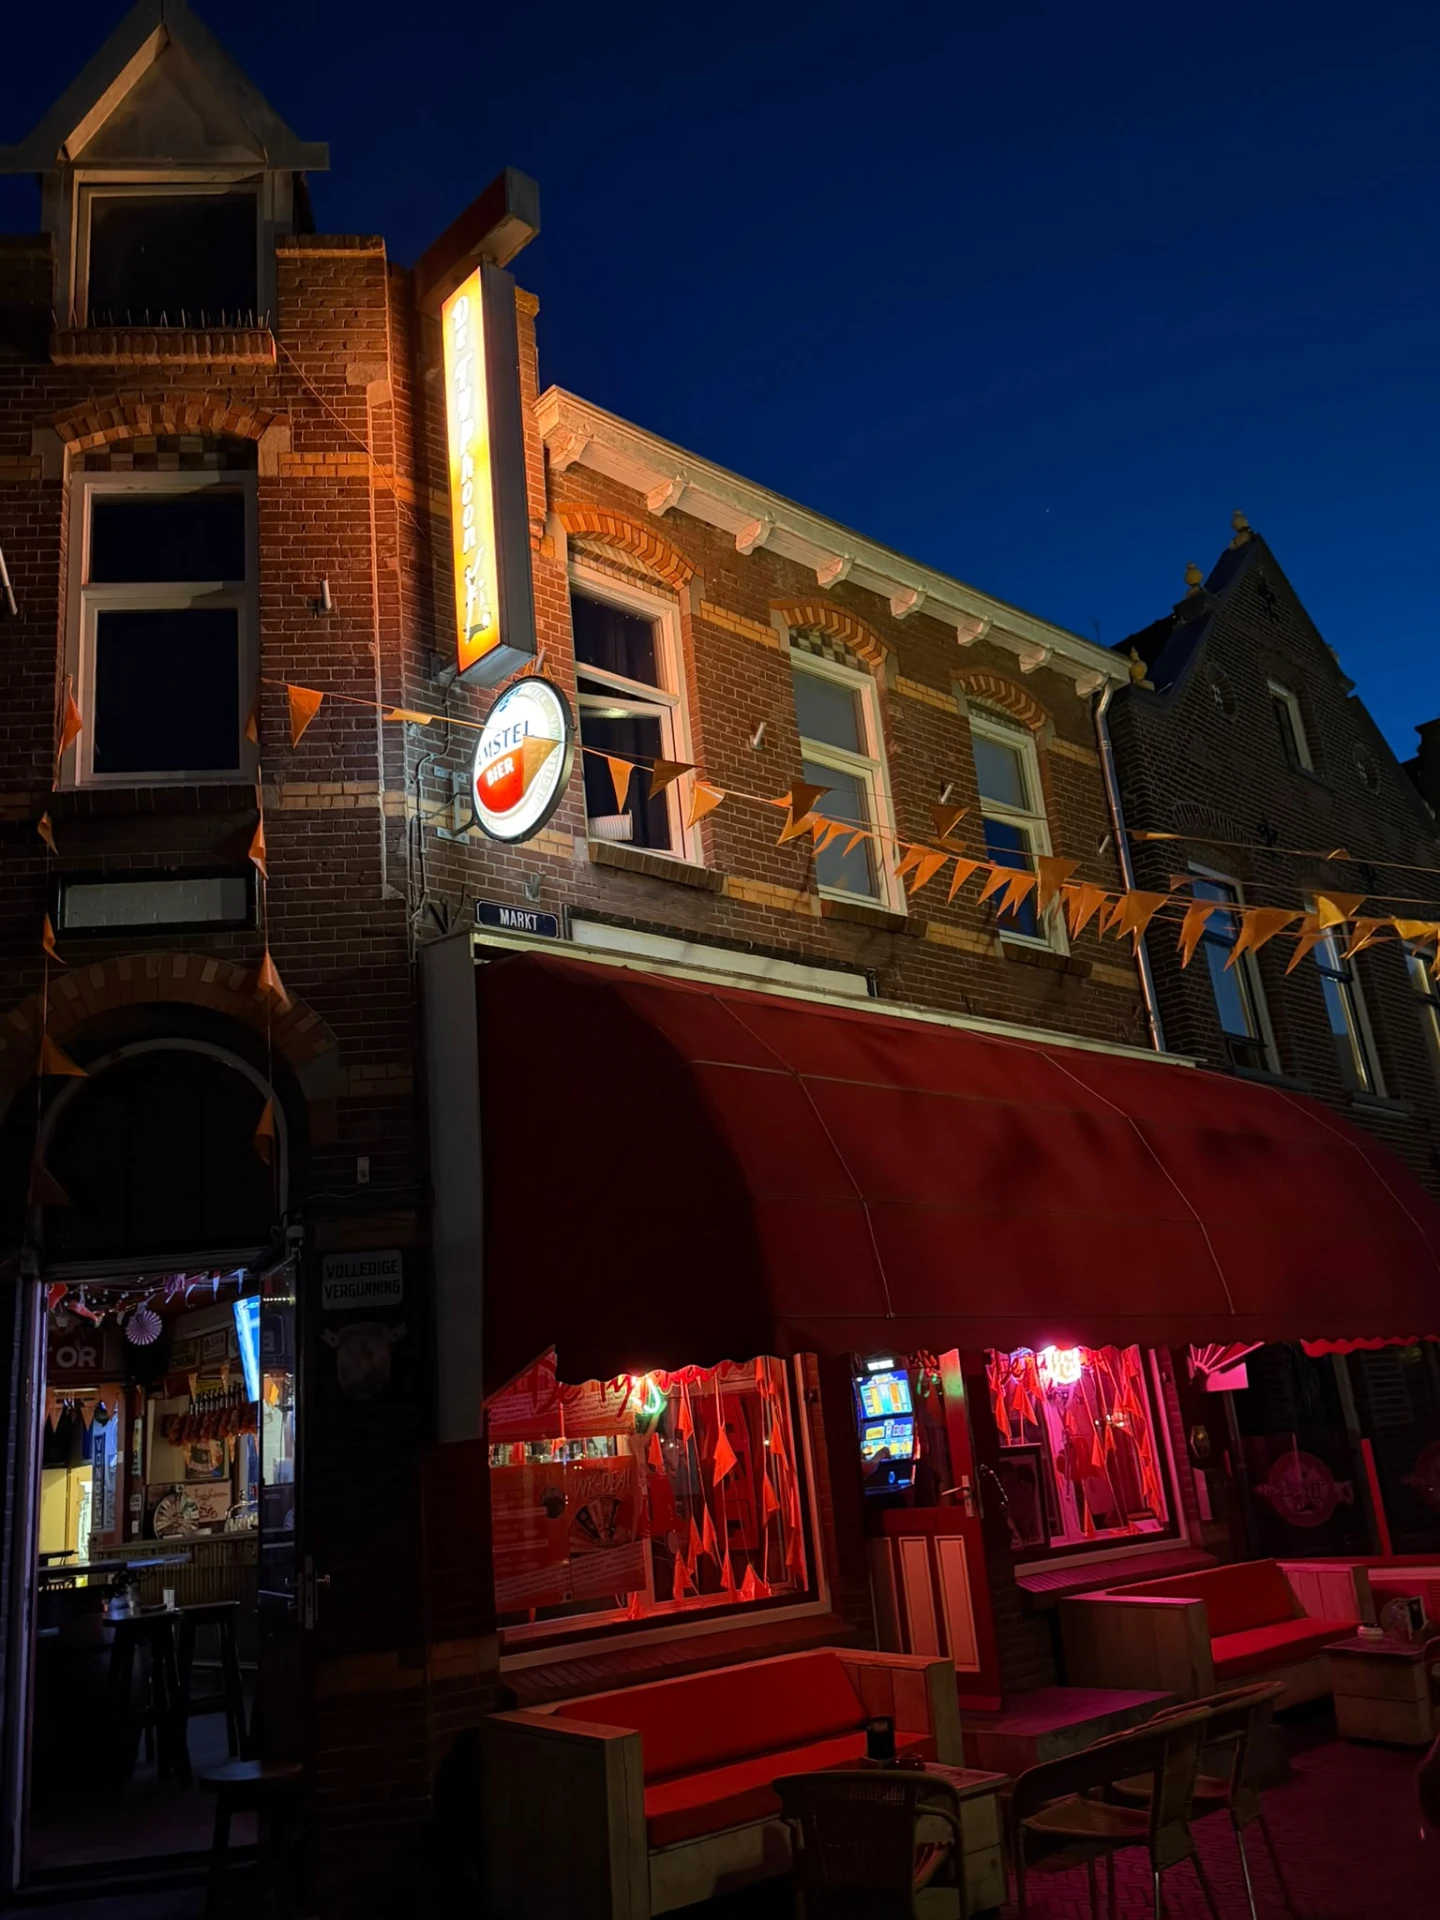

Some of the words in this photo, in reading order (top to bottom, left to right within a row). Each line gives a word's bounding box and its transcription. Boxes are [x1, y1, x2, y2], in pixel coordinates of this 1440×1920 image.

[477, 719, 535, 767] AMSTEL
[486, 757, 515, 788] BIER
[499, 907, 538, 931] MARKT
[325, 1259, 398, 1279] VOLLEDIGE
[324, 1279, 400, 1299] VERGUNNING
